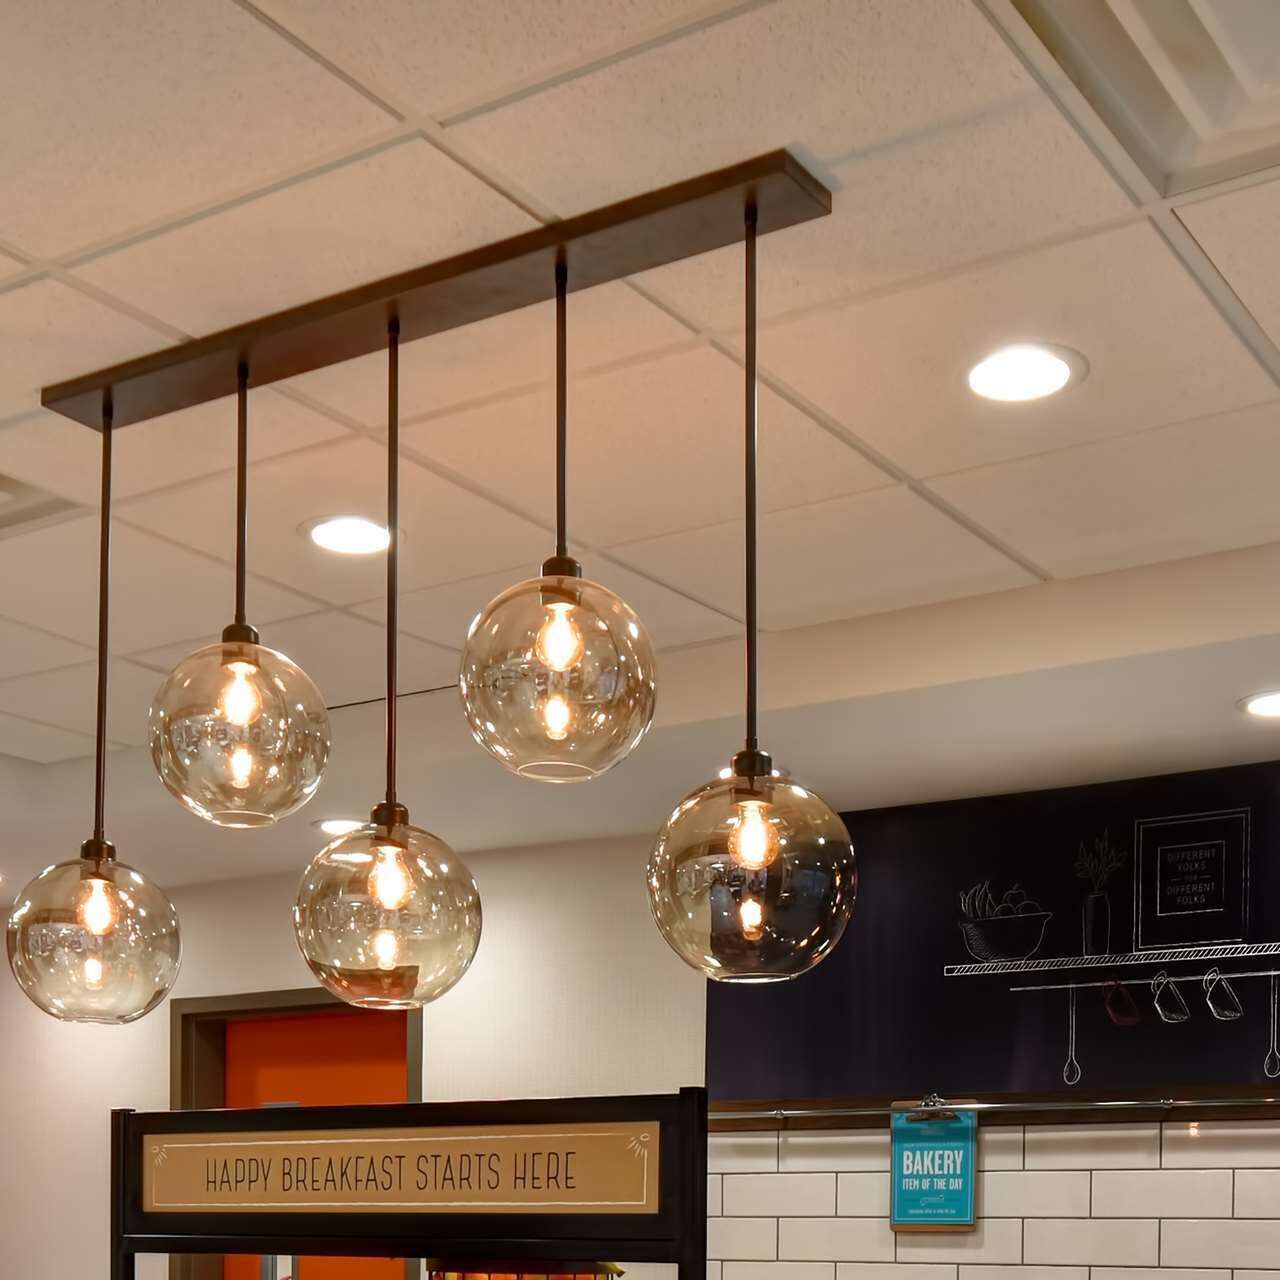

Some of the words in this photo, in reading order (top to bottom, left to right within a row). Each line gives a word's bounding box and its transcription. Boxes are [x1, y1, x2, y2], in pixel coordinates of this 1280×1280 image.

[1166, 882, 1215, 897] DIFFERENT
[206, 1157, 272, 1193] HAPPY
[282, 1155, 406, 1192] BREAKFAST
[416, 1153, 501, 1191] STARTS
[513, 1151, 577, 1190] HERE
[902, 1150, 964, 1175] BAKERY
[902, 1179, 919, 1190] ITEM
[921, 1179, 930, 1190] OF
[933, 1179, 947, 1190] THE
[949, 1179, 963, 1190] DAY
